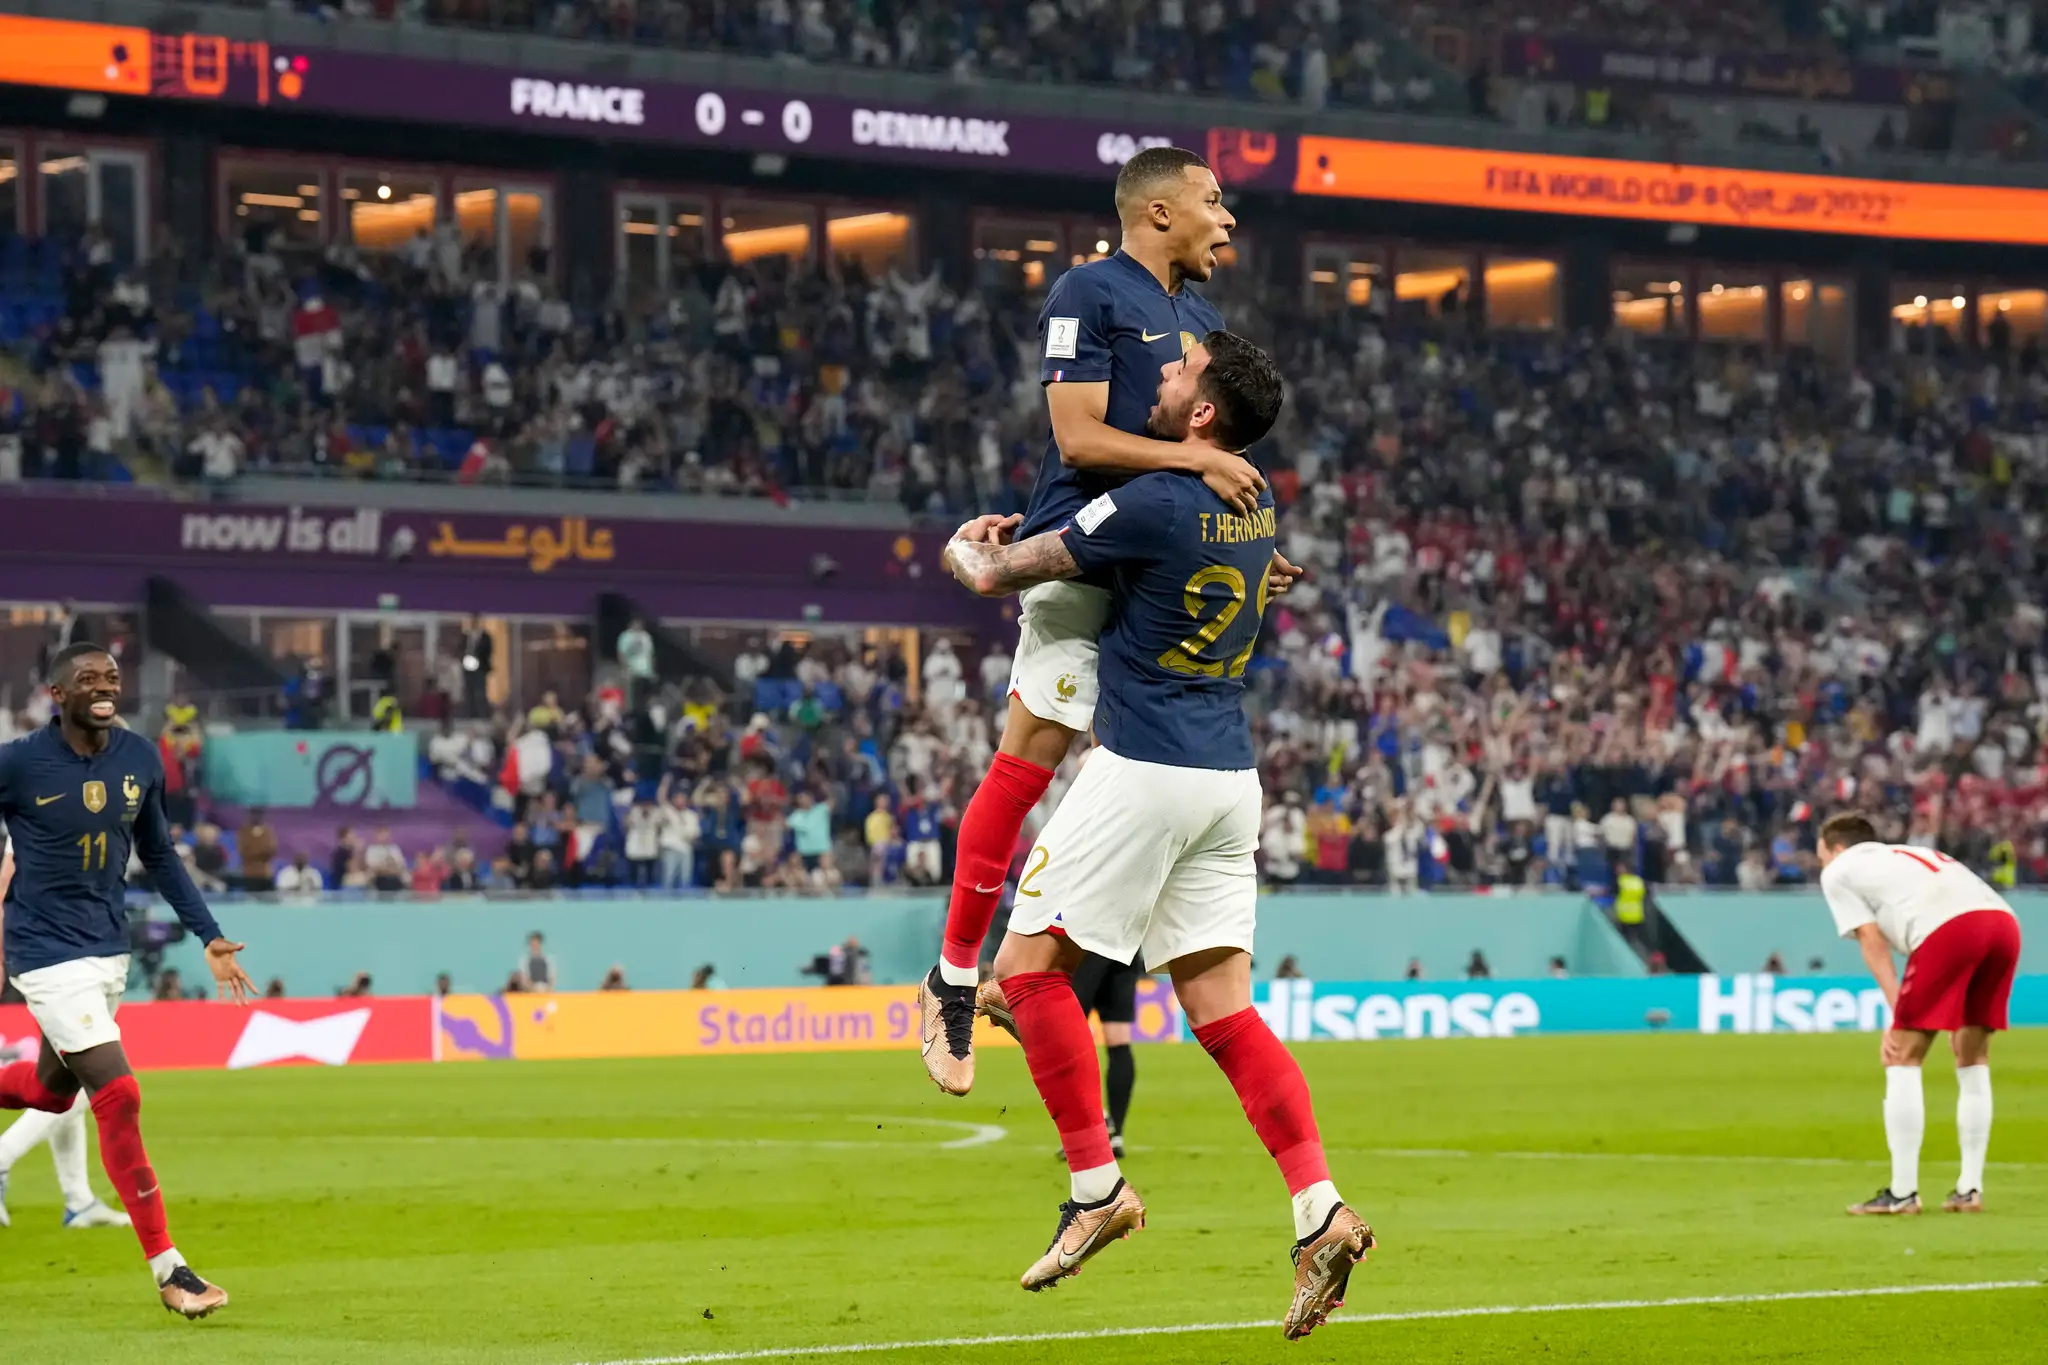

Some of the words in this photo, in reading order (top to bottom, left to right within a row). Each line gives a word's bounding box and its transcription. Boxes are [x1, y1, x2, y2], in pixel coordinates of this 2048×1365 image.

[510, 78, 644, 125] FRANCE
[695, 92, 727, 135] 0
[781, 100, 812, 143] 0
[852, 109, 1009, 155] DENMARK
[1486, 167, 1541, 196] FIFA
[1549, 172, 1641, 204] WORLD
[1646, 180, 1694, 206] CUP
[181, 514, 283, 551] now
[287, 505, 323, 551] is
[327, 508, 382, 554] all
[77, 831, 107, 871] 11
[1018, 845, 1049, 897] 2
[700, 1002, 873, 1047] Stadium
[1251, 977, 1540, 1041] Hisense
